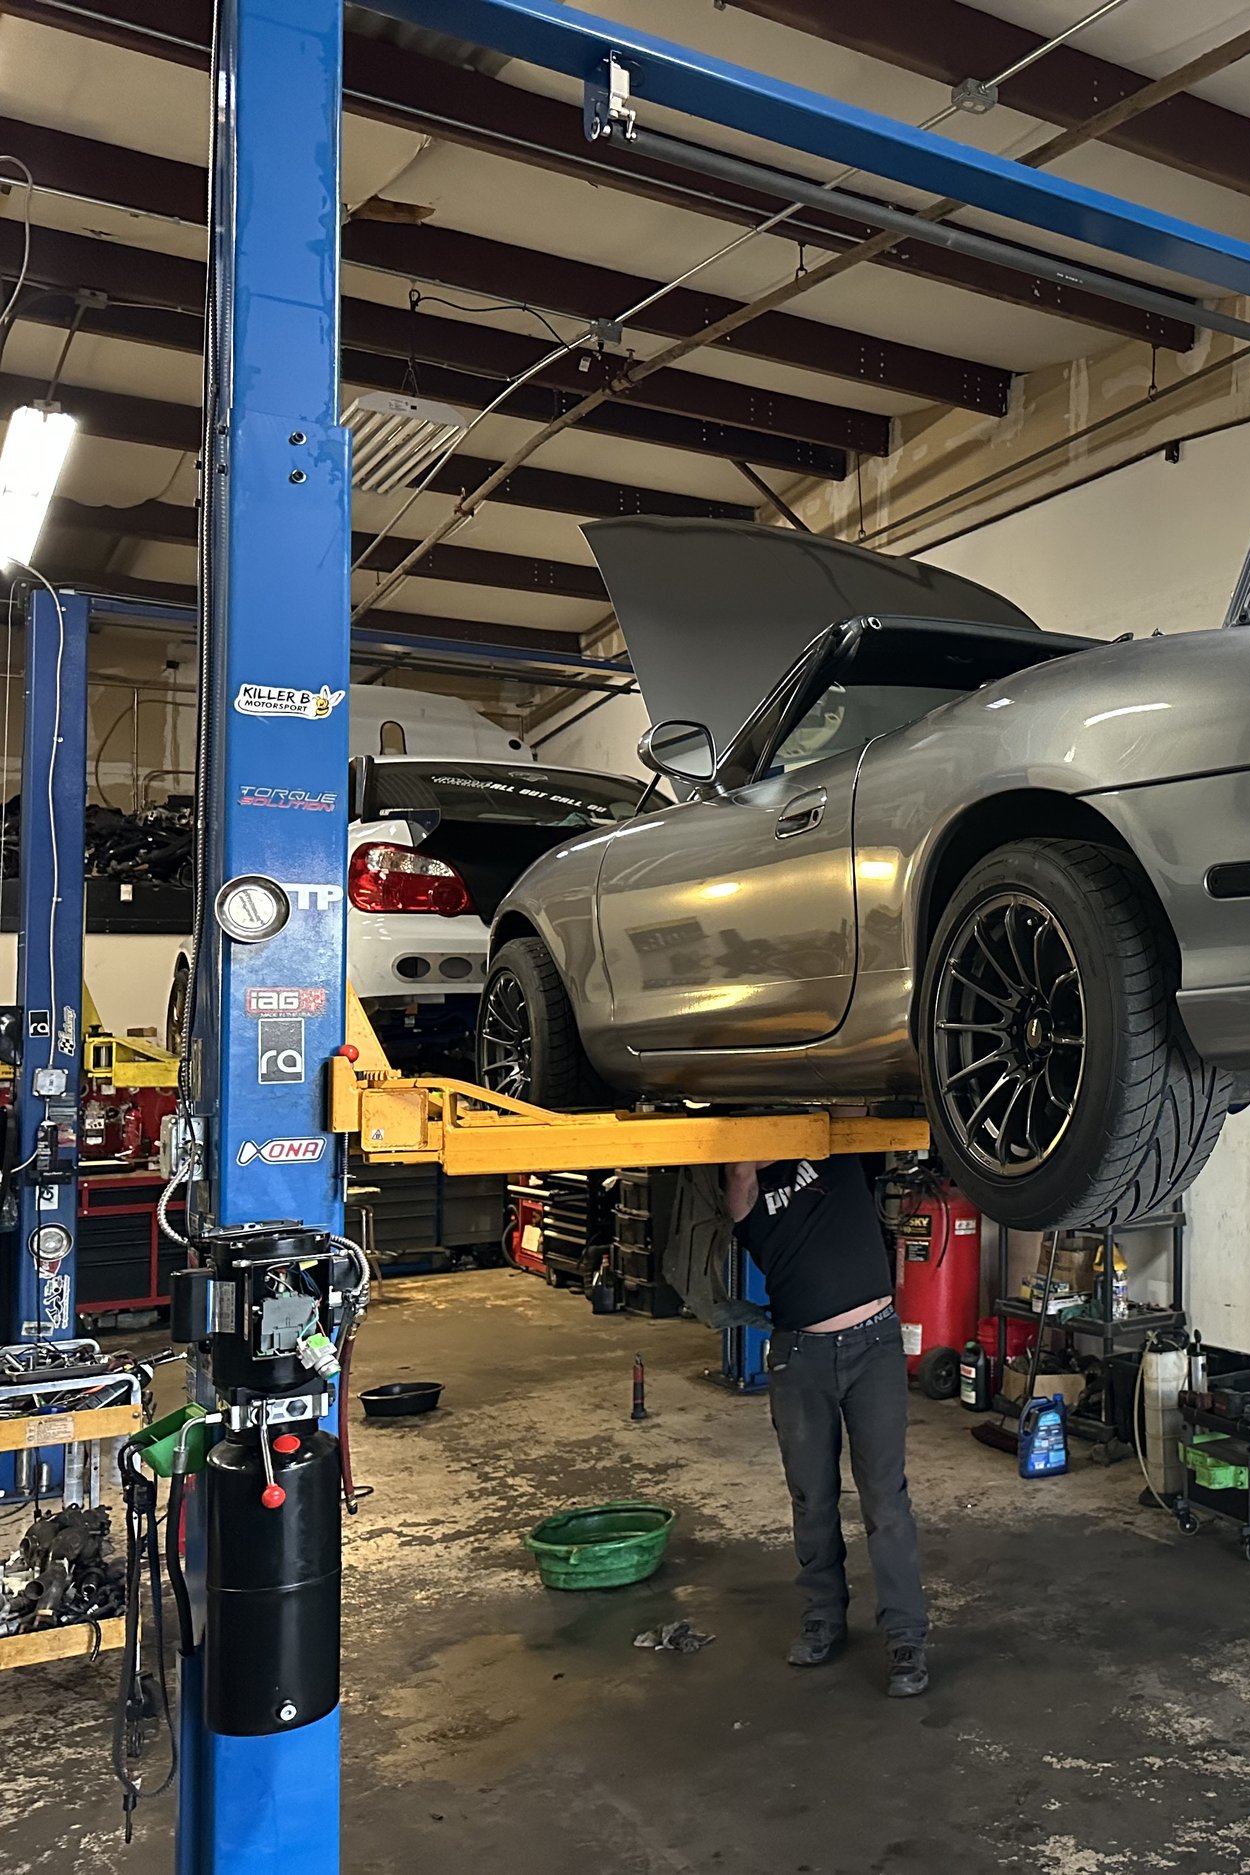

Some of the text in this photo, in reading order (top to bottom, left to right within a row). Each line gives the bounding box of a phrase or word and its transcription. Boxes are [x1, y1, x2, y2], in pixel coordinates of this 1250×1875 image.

[243, 686, 311, 704] KILLER B
[244, 699, 308, 713] MOTORSPORT
[240, 786, 338, 804] TORQUE
[240, 797, 335, 813] SOLUTION
[280, 883, 344, 910] TP
[261, 1050, 302, 1074] ra
